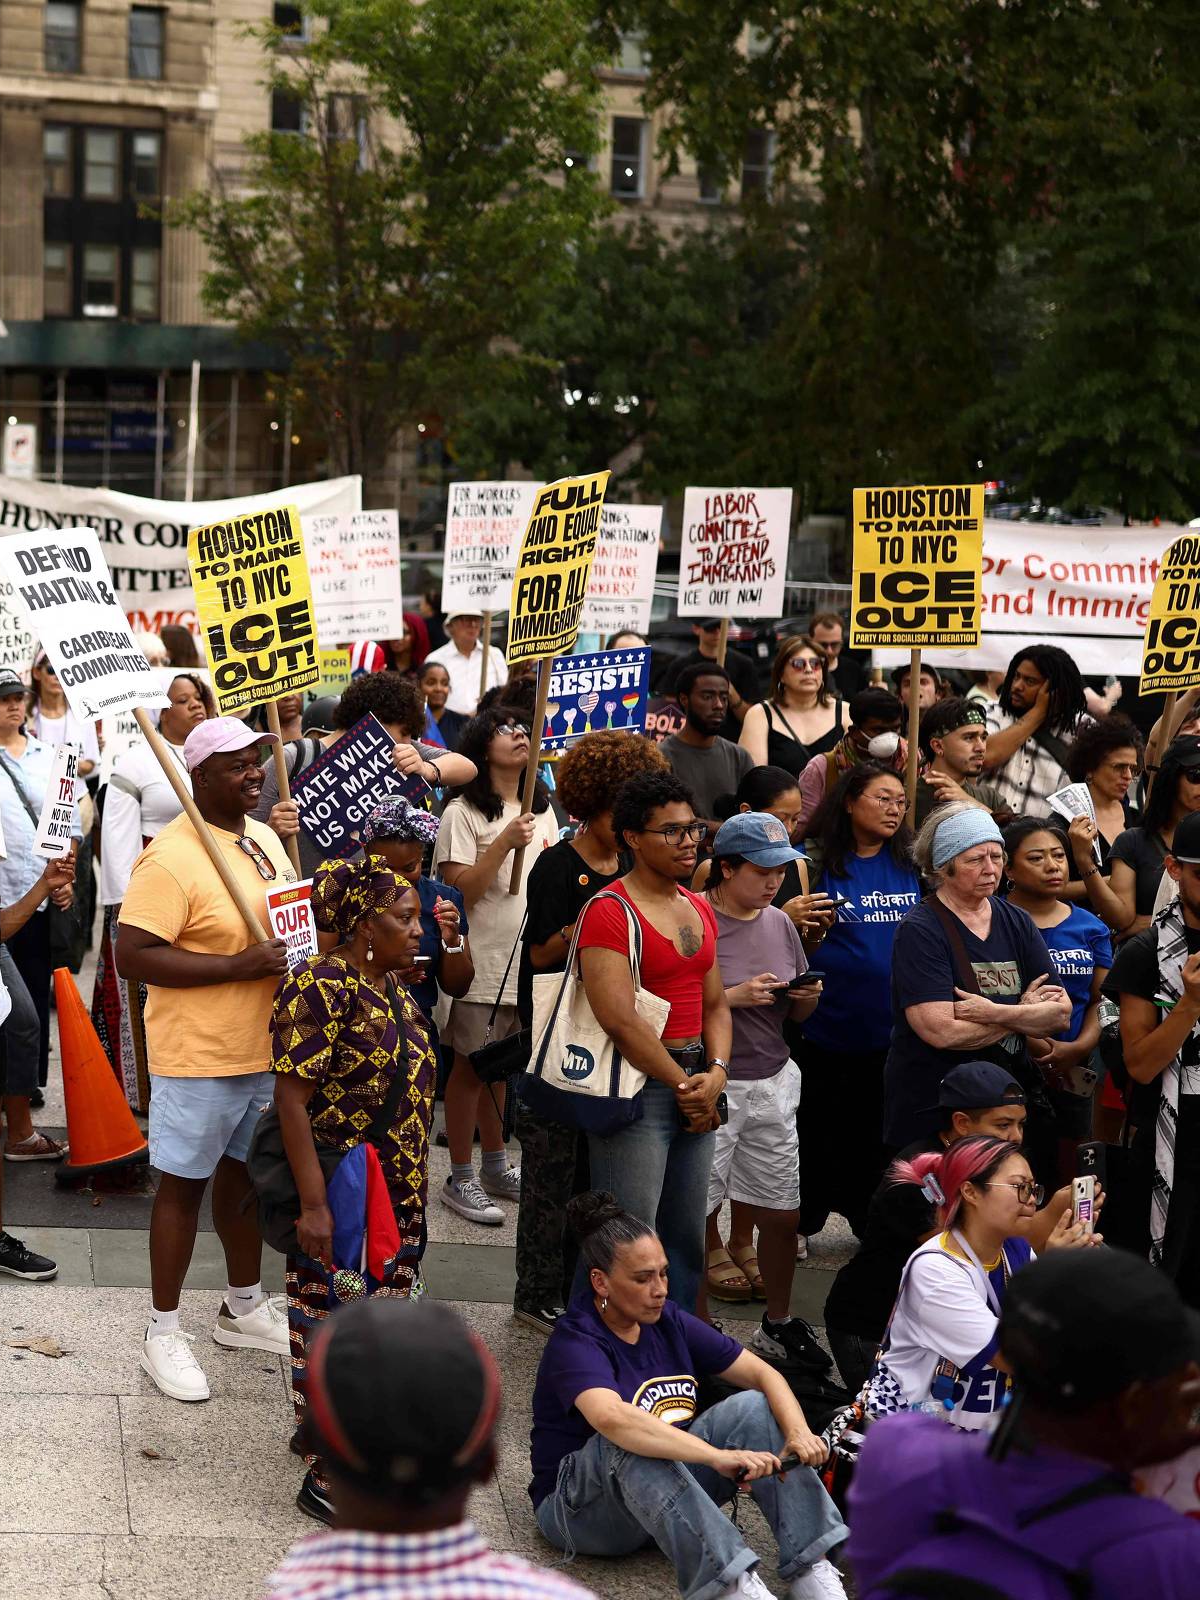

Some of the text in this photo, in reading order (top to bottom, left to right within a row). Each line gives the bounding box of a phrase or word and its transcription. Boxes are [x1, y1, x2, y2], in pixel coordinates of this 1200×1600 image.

[454, 486, 521, 502] FOR WORKERS
[535, 480, 603, 516] FULL
[705, 493, 760, 521] LABOR
[865, 488, 971, 519] HOUSTON
[0, 500, 124, 545] HUNTER
[312, 514, 388, 532] STOP ATTACK
[452, 503, 514, 517] ACTION NOW
[197, 508, 293, 563] HOUSTON
[525, 505, 599, 548] AND EQUAL
[600, 527, 656, 545] PORTATIONS
[859, 519, 978, 533] TO MAINE
[15, 545, 92, 576] DEFND
[195, 541, 301, 580] TO MAINE
[451, 545, 510, 562] HAITIANS!
[520, 537, 596, 568] RIGHTS
[697, 539, 770, 566] TO DEFEND
[877, 534, 958, 565] TO NYC
[612, 564, 638, 577] CARE
[687, 558, 776, 586] IMMIGRANTS
[1023, 553, 1161, 584] Commit
[1162, 568, 1184, 580] TO
[97, 580, 117, 606] &
[216, 564, 291, 613] TO NYC
[322, 579, 347, 593] USE
[516, 564, 589, 616] FOR ALL
[684, 587, 762, 605] ICE OUT NOW!
[859, 571, 975, 603] ICE
[1167, 583, 1190, 611] TO
[207, 599, 313, 662] ICE
[511, 600, 585, 642] IMMIGRANT
[855, 606, 975, 629] OUT!
[524, 643, 535, 654] FOR
[856, 633, 975, 643] PARTY FOR SOCIALISM & LIBERATION
[215, 639, 316, 690] OUT!
[323, 658, 347, 668] FOR
[220, 695, 238, 710] PARTY
[289, 669, 319, 688] LIBERATION
[548, 665, 642, 698] RESIST!
[1160, 675, 1185, 687] SOCIALISM
[334, 731, 383, 772] WILL
[59, 778, 75, 803] TPS
[291, 767, 338, 814] HATE
[302, 744, 394, 831] NOT MAKE
[51, 808, 60, 820] NO
[315, 768, 408, 848] US GREAT
[48, 822, 59, 837] ON
[860, 890, 917, 908] अधिकार
[275, 904, 310, 936] OUR
[1049, 948, 1094, 961] धिकार
[977, 969, 1017, 988] ESIST
[562, 1050, 588, 1070] MTA
